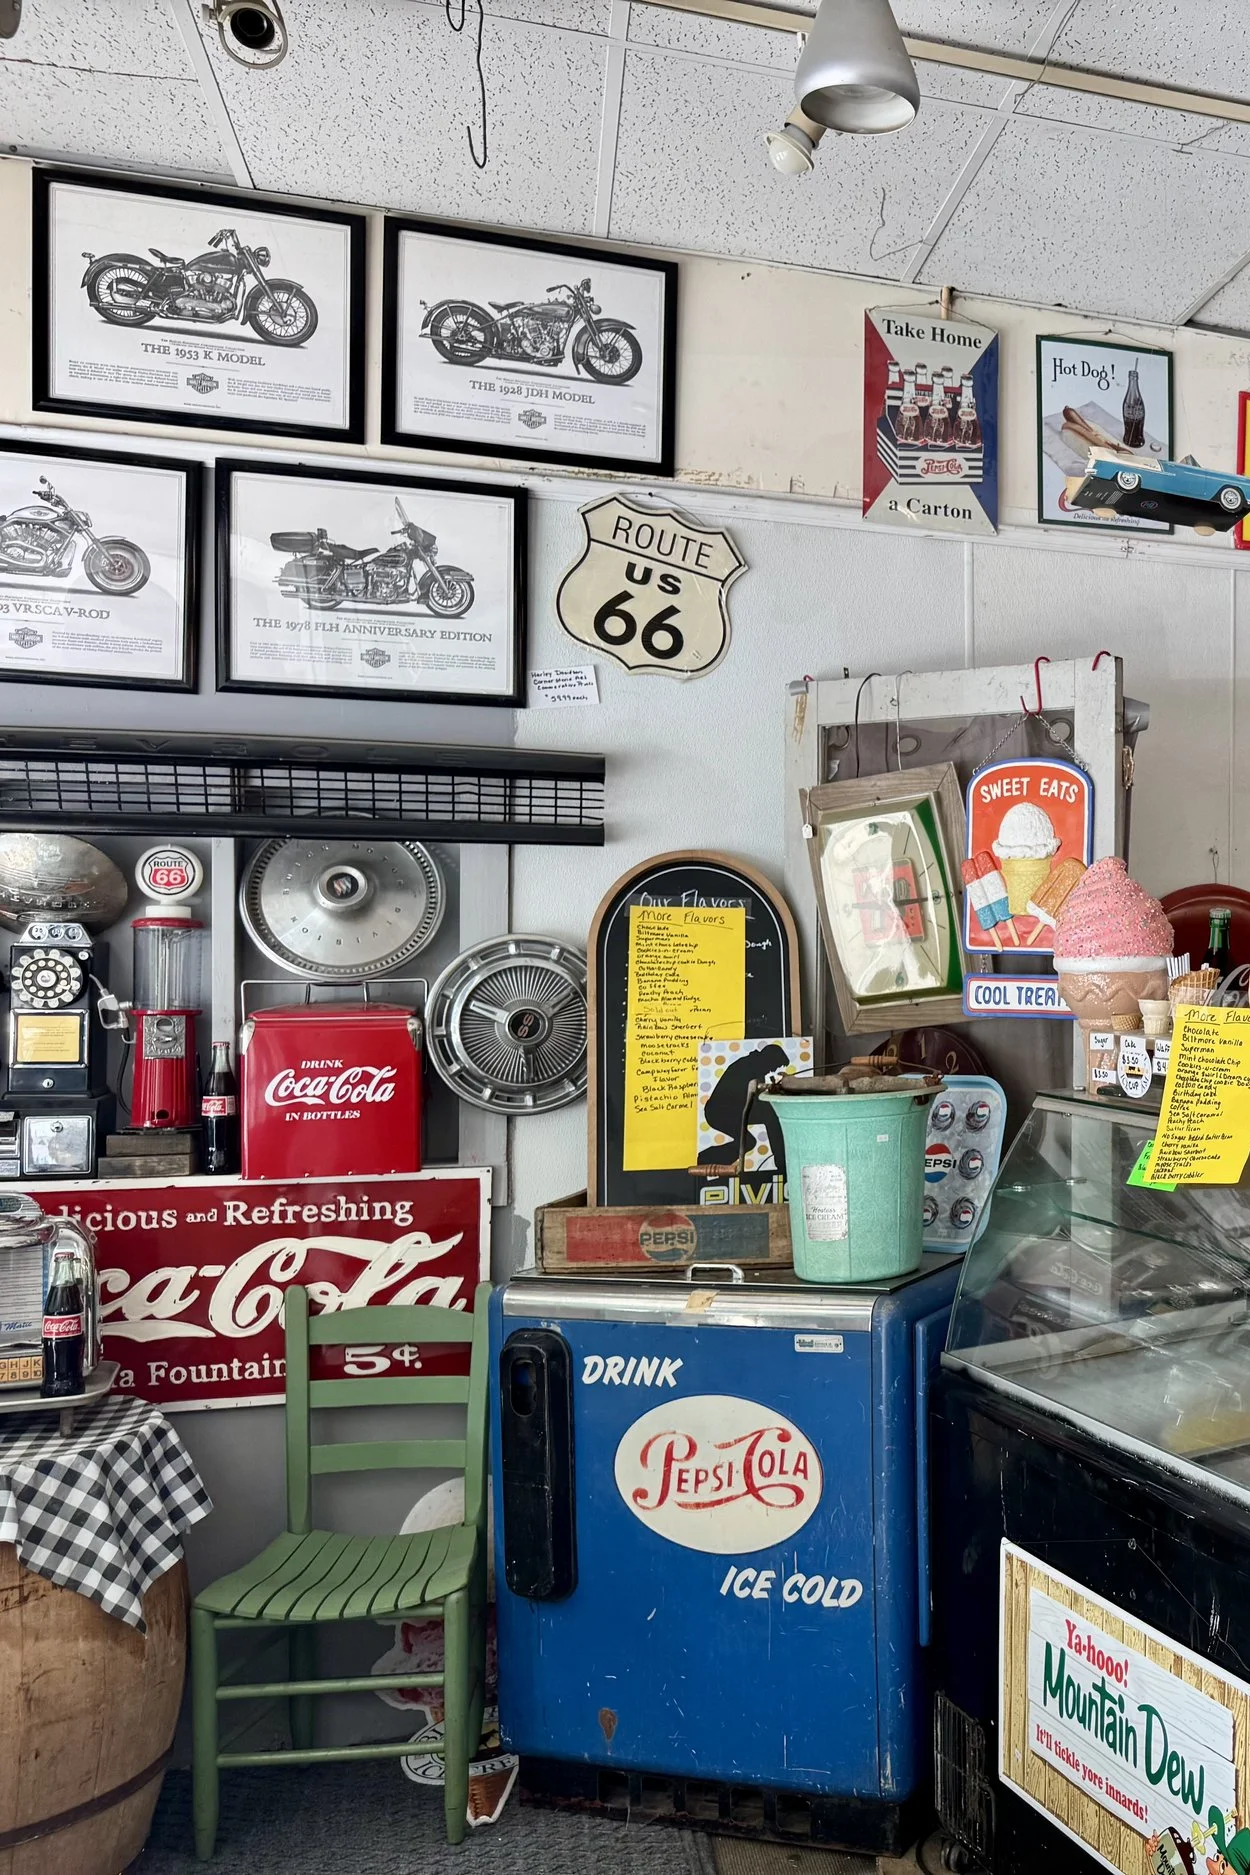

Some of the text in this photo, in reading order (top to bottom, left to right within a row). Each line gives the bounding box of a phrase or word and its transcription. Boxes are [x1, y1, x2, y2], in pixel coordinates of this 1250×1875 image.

[882, 317, 982, 350] Take Home
[141, 343, 171, 356] THE
[175, 347, 199, 361] 1953
[203, 350, 214, 361] K
[217, 353, 265, 366] MODEL
[1052, 357, 1115, 391] Hot Dog!
[469, 379, 595, 405] THE 1928 JDH MODEL
[905, 497, 973, 521] Carton
[612, 515, 714, 569] ROUTE
[625, 561, 682, 595] US
[63, 606, 110, 620] V-ROD
[253, 616, 492, 643] THE 1978 FLH ANNIVERSARY EDITION
[594, 590, 684, 660] 66
[980, 776, 1079, 804] SWEET EATS
[153, 859, 184, 868] ROUTE
[155, 870, 183, 885] 66
[636, 910, 726, 925] More Flavors
[974, 984, 1064, 1007] COOL TREA
[1184, 1009, 1217, 1022] More
[1094, 1035, 1109, 1048] Sugar
[1182, 1034, 1215, 1045] Biltmore
[1183, 1025, 1219, 1037] Chocolate
[1178, 1053, 1197, 1062] Mint
[1180, 1043, 1215, 1054] Superman
[300, 1059, 344, 1069] DRINK
[264, 1065, 398, 1107] Coca-Cola
[1172, 1088, 1201, 1099] Birthday
[633, 1095, 679, 1103] Pistachio
[285, 1110, 361, 1121] IN BOTTLES
[1168, 1110, 1181, 1118] Sea
[924, 1158, 957, 1169] EPSI
[186, 1207, 218, 1223] and
[222, 1194, 414, 1229] Refreshing
[640, 1230, 694, 1247] PEPSI
[581, 1354, 684, 1389] DRINK
[719, 1565, 864, 1609] ICE COLD
[1064, 1617, 1130, 1689] Ya-hooo!
[1042, 1640, 1205, 1815] Mountain Dew
[1035, 1723, 1150, 1825] It'll tickle yore innards!
